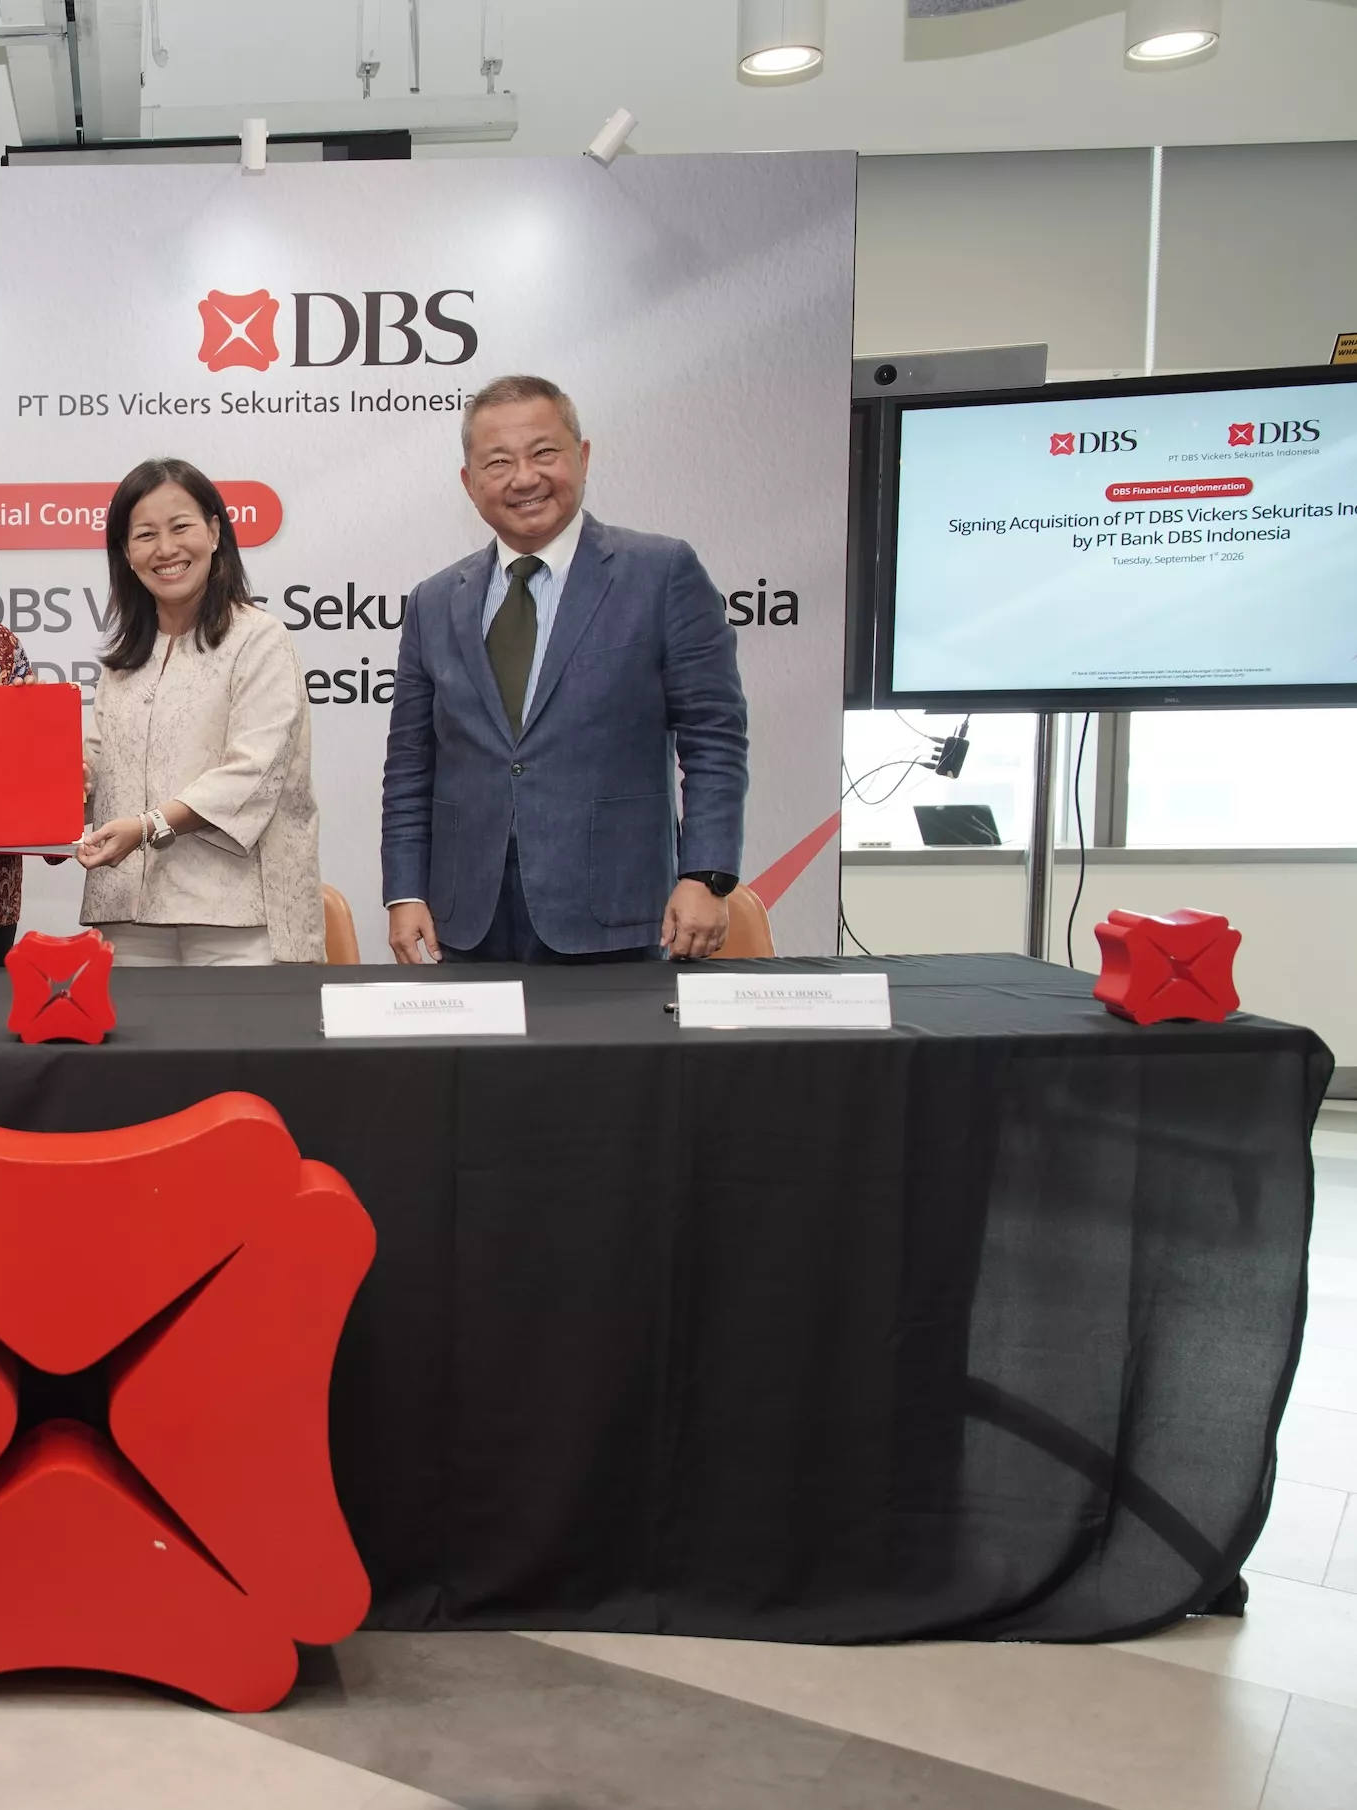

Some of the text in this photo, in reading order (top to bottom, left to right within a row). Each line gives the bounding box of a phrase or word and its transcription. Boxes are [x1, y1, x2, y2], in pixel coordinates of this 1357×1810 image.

[290, 289, 478, 367] DBS
[18, 395, 48, 417] PT
[59, 394, 109, 416] DBS
[119, 392, 211, 415] Vickers
[221, 390, 340, 415] Sekuritas
[1079, 429, 1137, 454] DBS
[1258, 419, 1320, 445] DBS
[1181, 454, 1198, 462] DBS
[1201, 452, 1231, 461] Vickers
[1234, 450, 1274, 459] Sekuritas
[1277, 448, 1320, 457] Indonesia
[1113, 482, 1245, 496] DBS Financial Conglomeration
[949, 518, 1006, 535] Signing
[1009, 514, 1099, 533] Acquisition
[1103, 511, 1121, 526] of
[1125, 511, 1145, 525] PT
[1149, 510, 1183, 524] DBS
[1187, 507, 1247, 522] Vickers
[1252, 503, 1333, 519] Sekuritas
[1073, 526, 1290, 551] by PT Bank DBS Indonesia
[1112, 556, 1152, 566] Tuesday,
[1155, 554, 1206, 565] September
[1221, 552, 1244, 562] 2026
